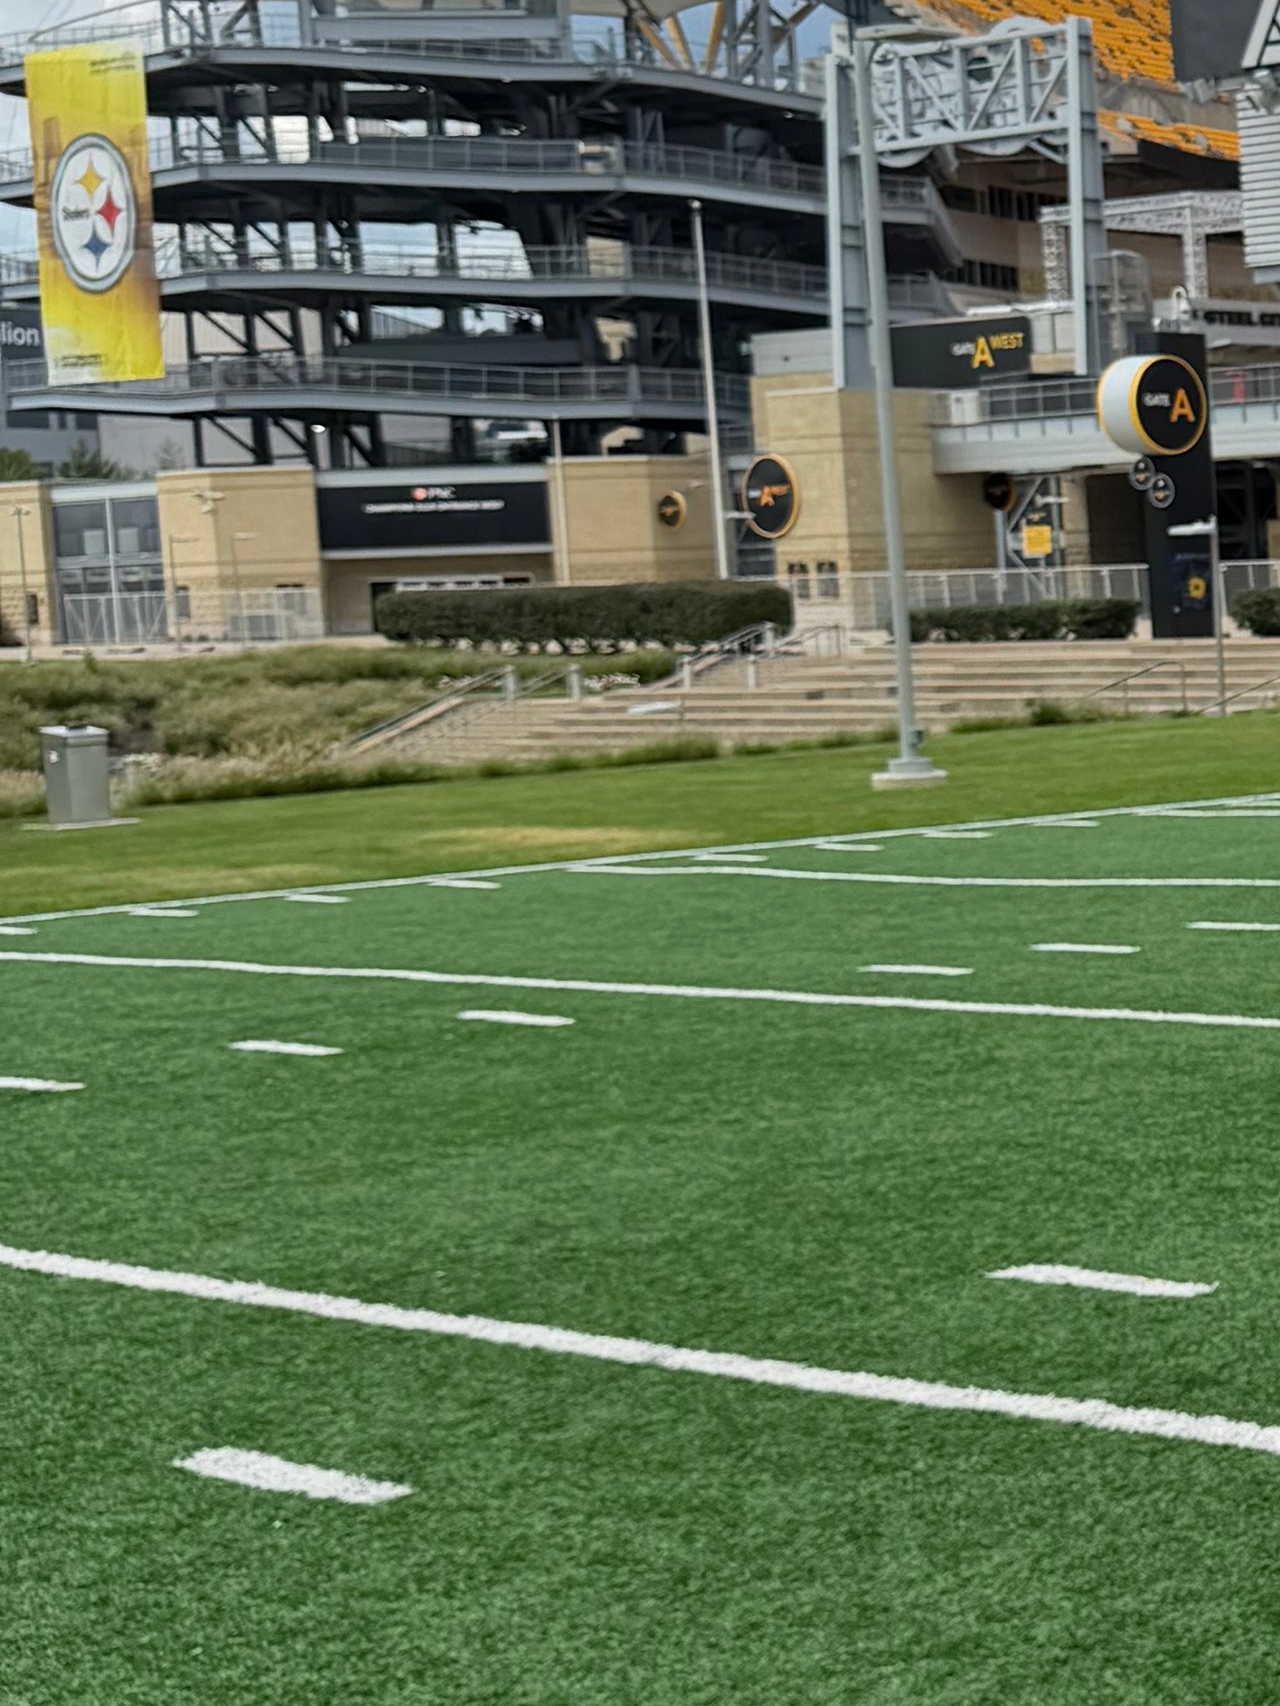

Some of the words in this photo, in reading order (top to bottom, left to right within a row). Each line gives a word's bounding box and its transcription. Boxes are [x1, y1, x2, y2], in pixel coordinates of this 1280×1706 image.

[972, 336, 996, 369] A
[989, 332, 1024, 350] WEST
[1143, 393, 1171, 407] GATE
[1169, 388, 1196, 423] A
